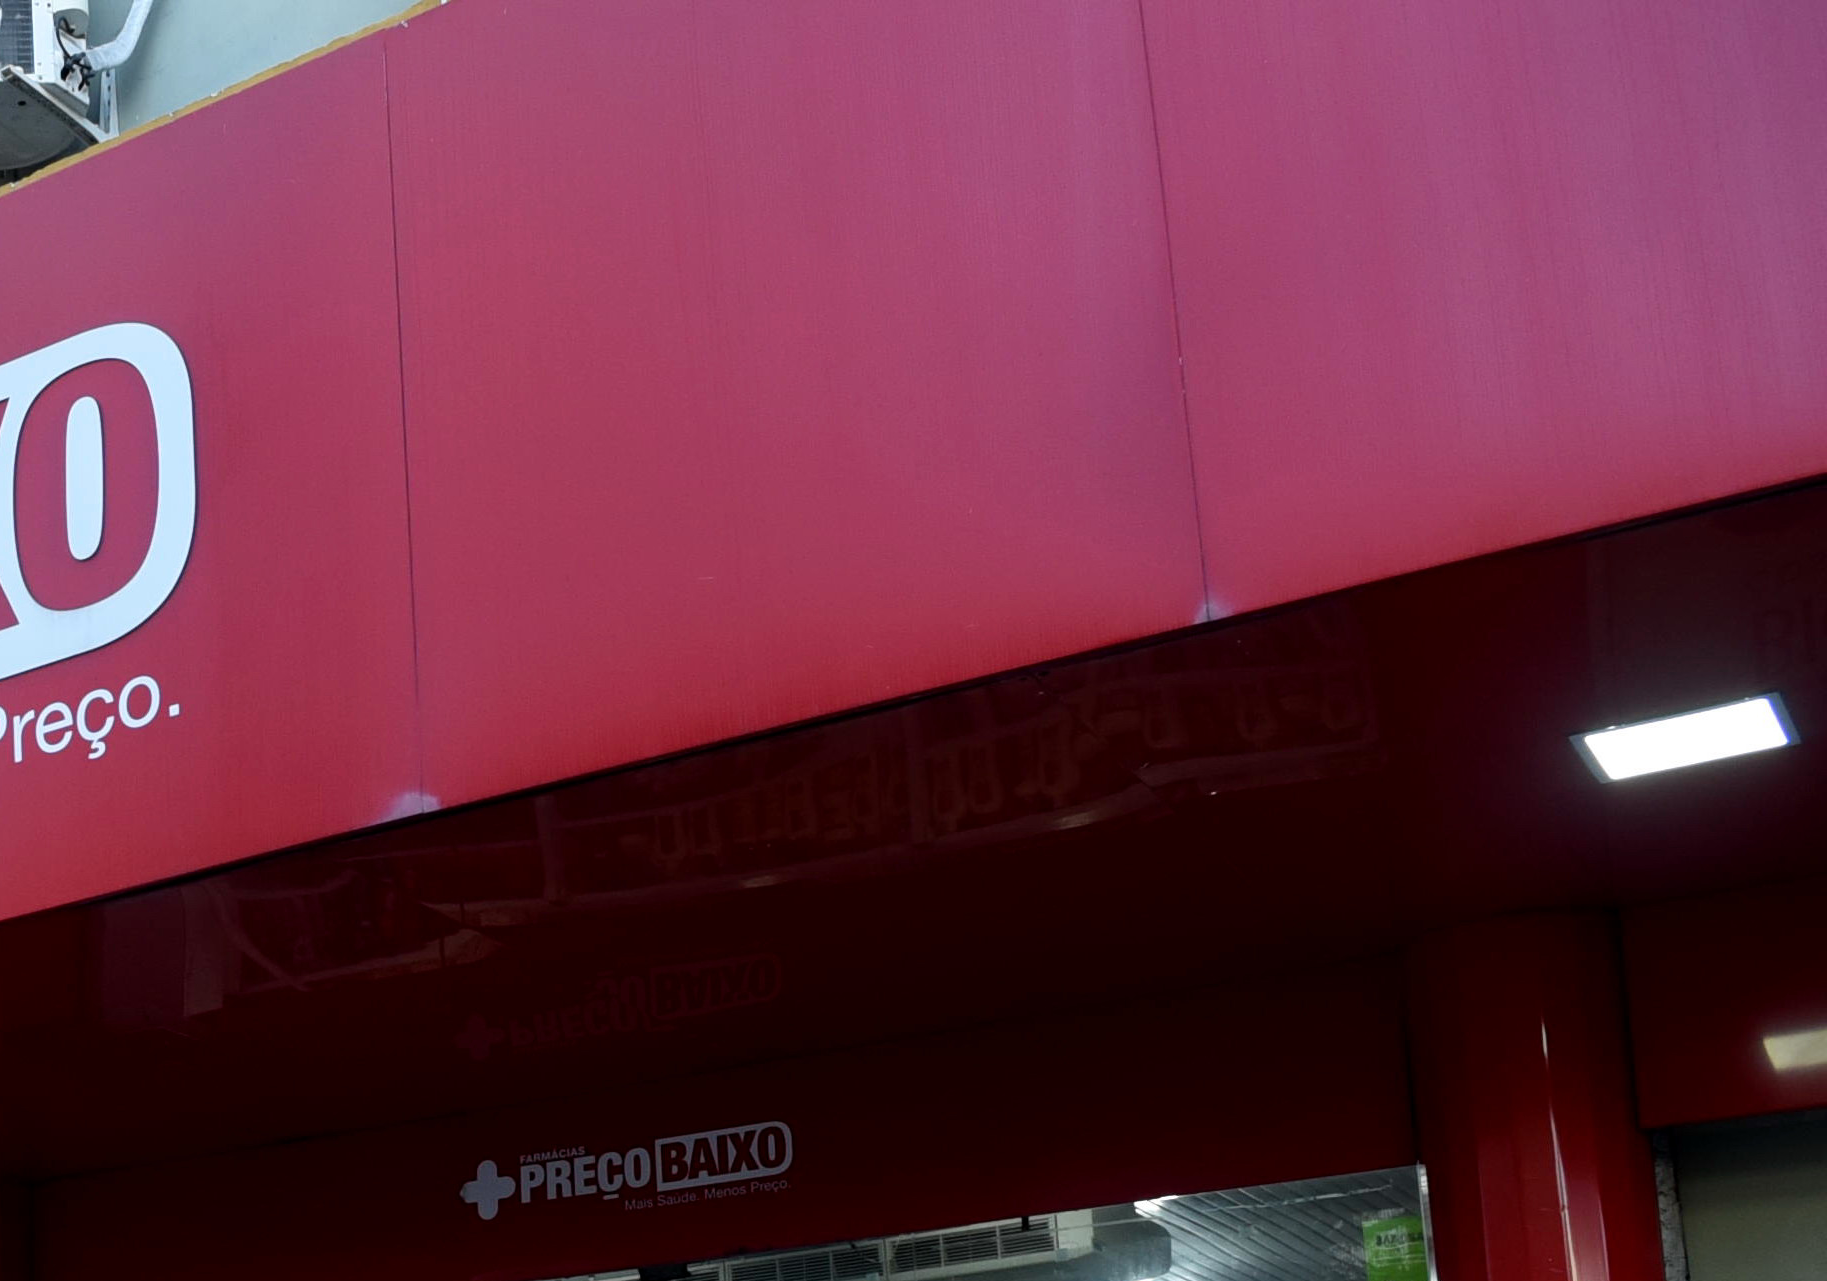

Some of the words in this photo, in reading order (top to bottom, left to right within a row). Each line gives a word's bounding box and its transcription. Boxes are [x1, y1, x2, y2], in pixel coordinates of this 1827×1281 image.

[520, 1145, 586, 1165] FARMÁCIAS
[624, 1196, 653, 1211] Mais
[657, 1191, 700, 1207] Saúde.
[704, 1185, 747, 1200] Menos
[750, 1178, 792, 1194] Preço.
